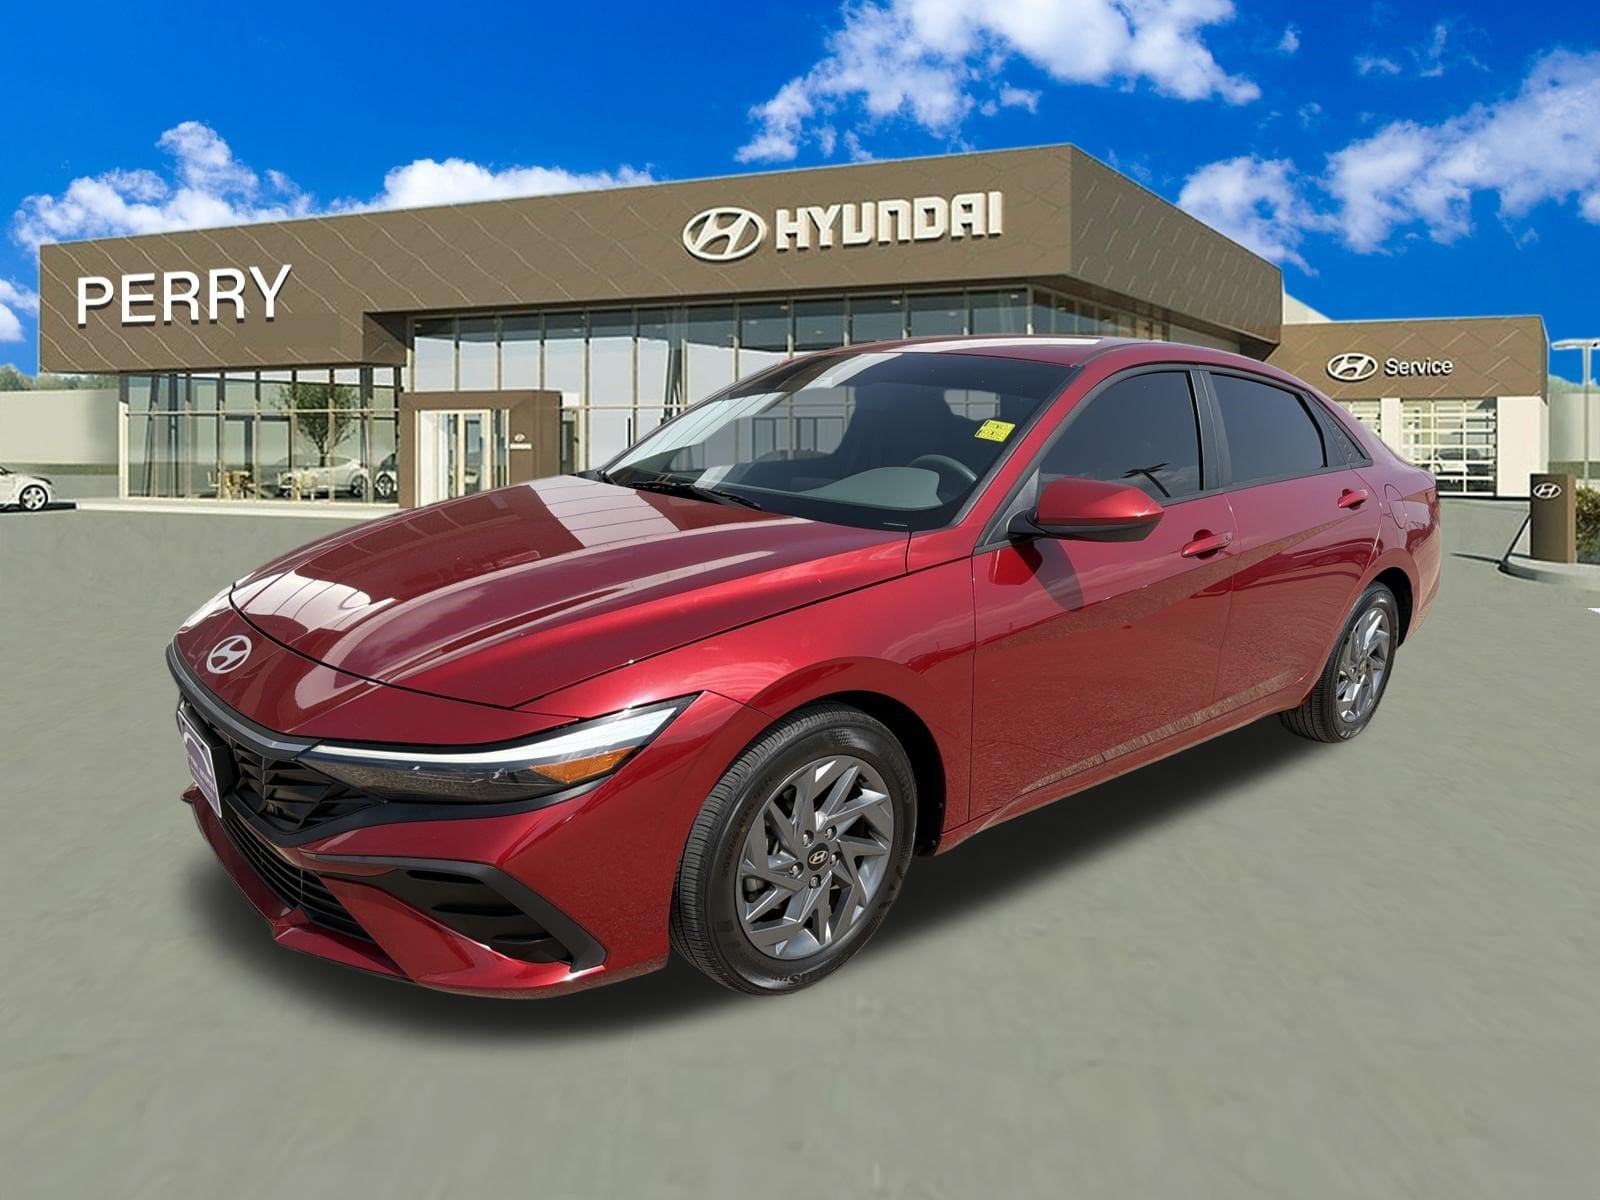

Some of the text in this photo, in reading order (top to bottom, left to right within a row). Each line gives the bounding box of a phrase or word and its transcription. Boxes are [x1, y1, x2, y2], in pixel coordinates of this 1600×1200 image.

[776, 191, 1004, 251] HYUNDAI
[77, 264, 291, 327] PERRY
[1384, 357, 1453, 377] Service
